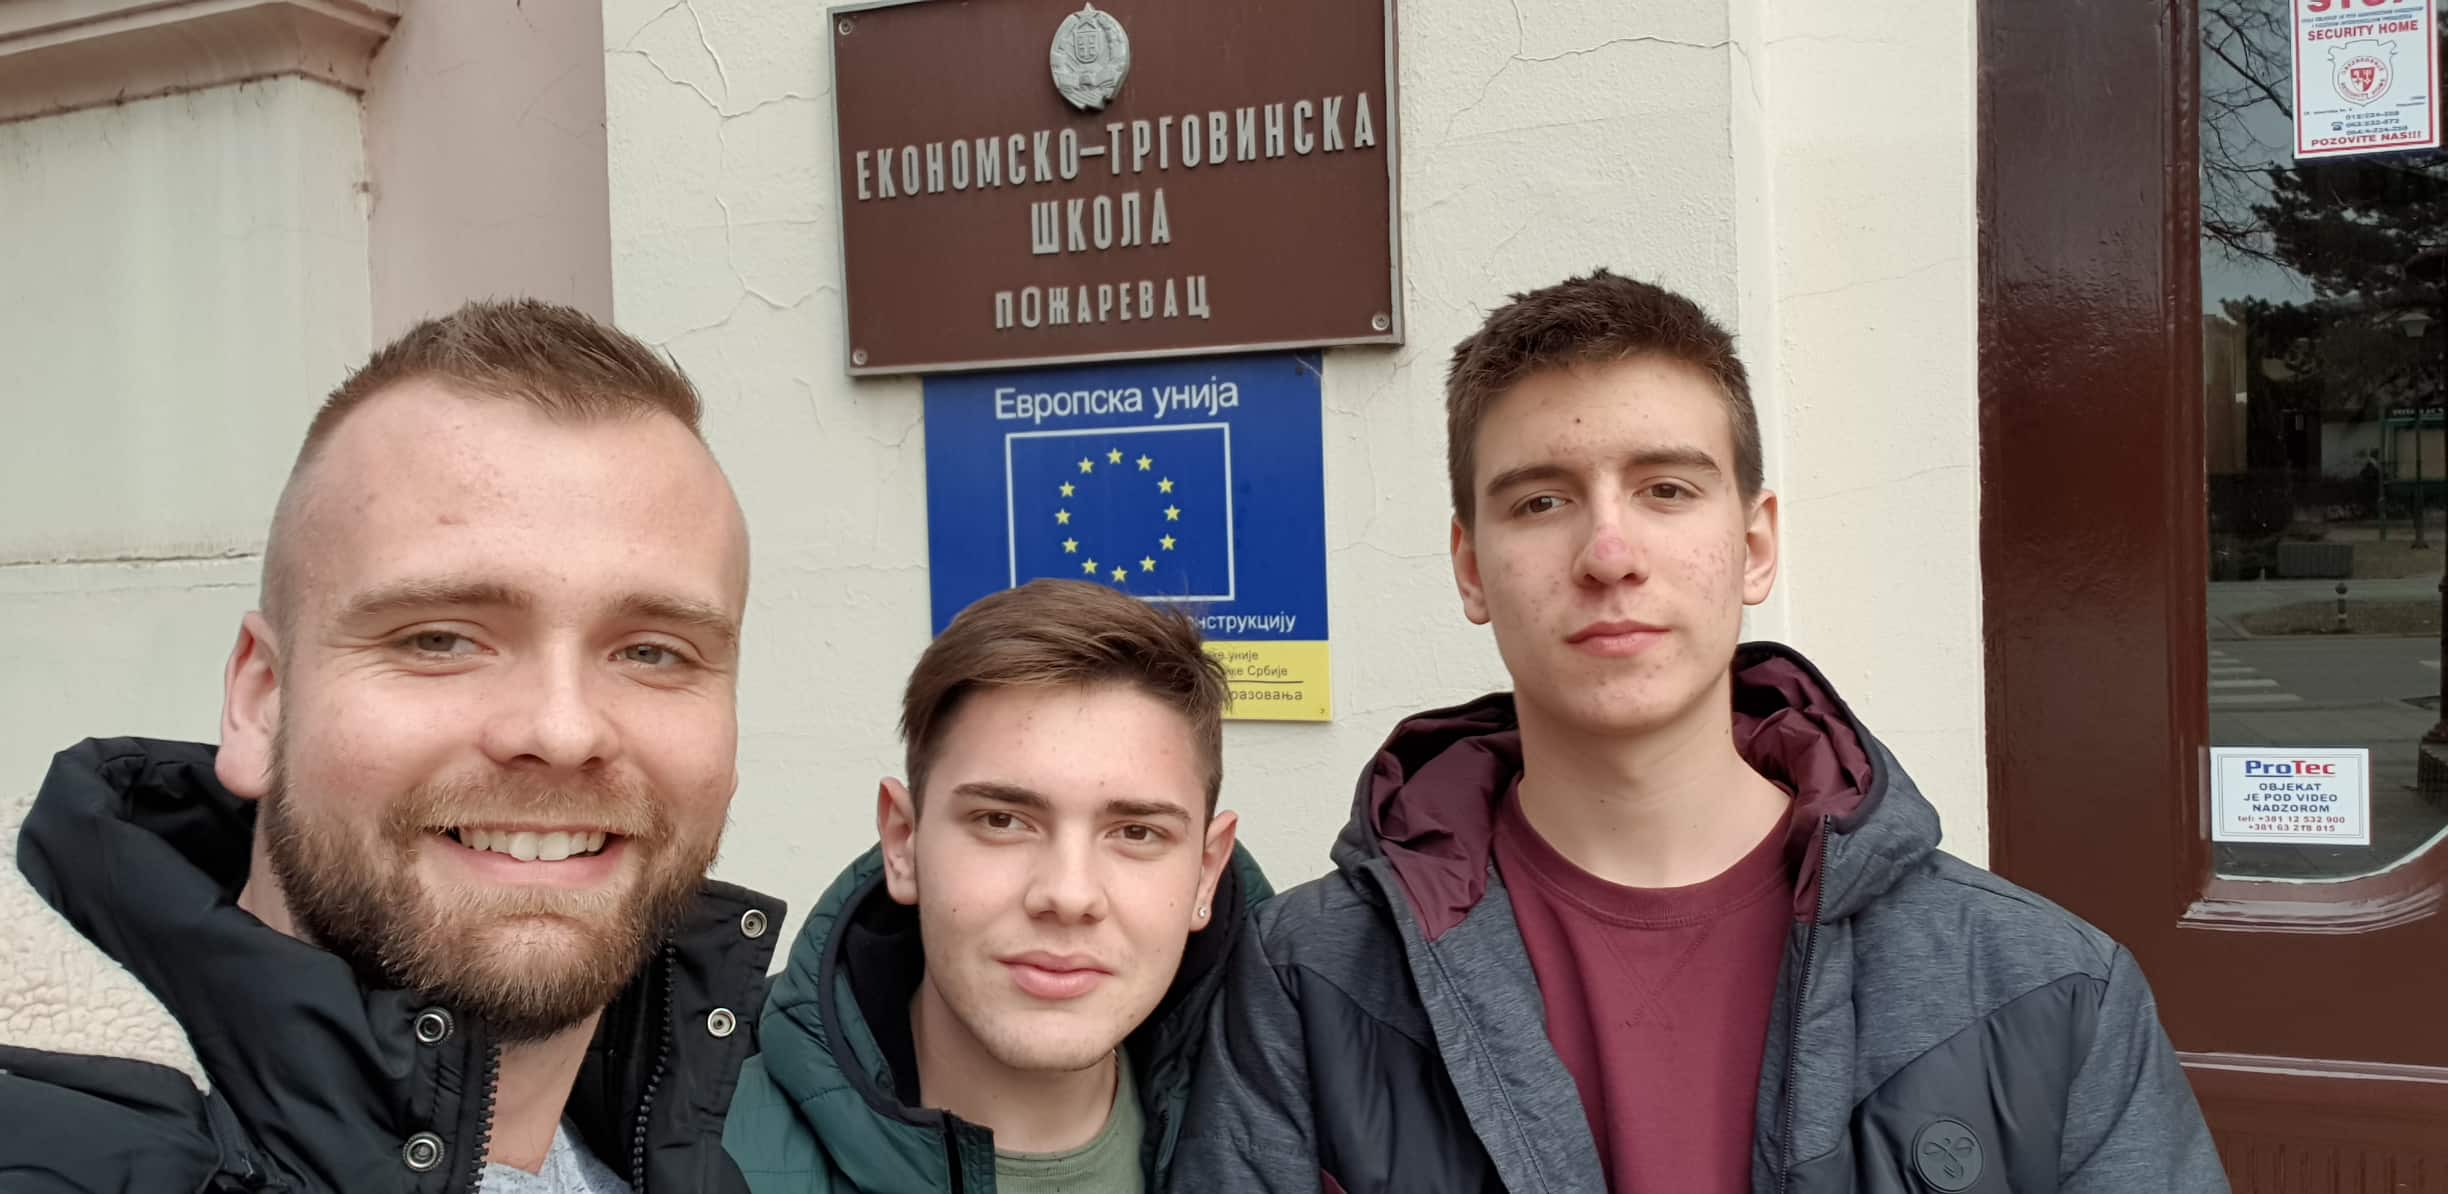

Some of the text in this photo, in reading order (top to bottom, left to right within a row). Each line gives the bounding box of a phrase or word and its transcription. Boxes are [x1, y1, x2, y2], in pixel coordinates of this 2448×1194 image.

[2307, 24, 2374, 41] SECURITY
[2378, 20, 2419, 34] HOME
[2311, 131, 2422, 147] POZOVITE NAS!!!
[1031, 188, 1171, 255] ШКОЛА
[995, 275, 1210, 329] ПОЖАРЕВАЦ
[995, 376, 1239, 424] Европска унија
[1247, 664, 1288, 679] Србије
[2245, 760, 2337, 775] ProTec
[2259, 783, 2322, 791] OBJEKAT
[2243, 793, 2338, 802] JE POD VIDEO
[2252, 804, 2330, 813] NADZOROM
